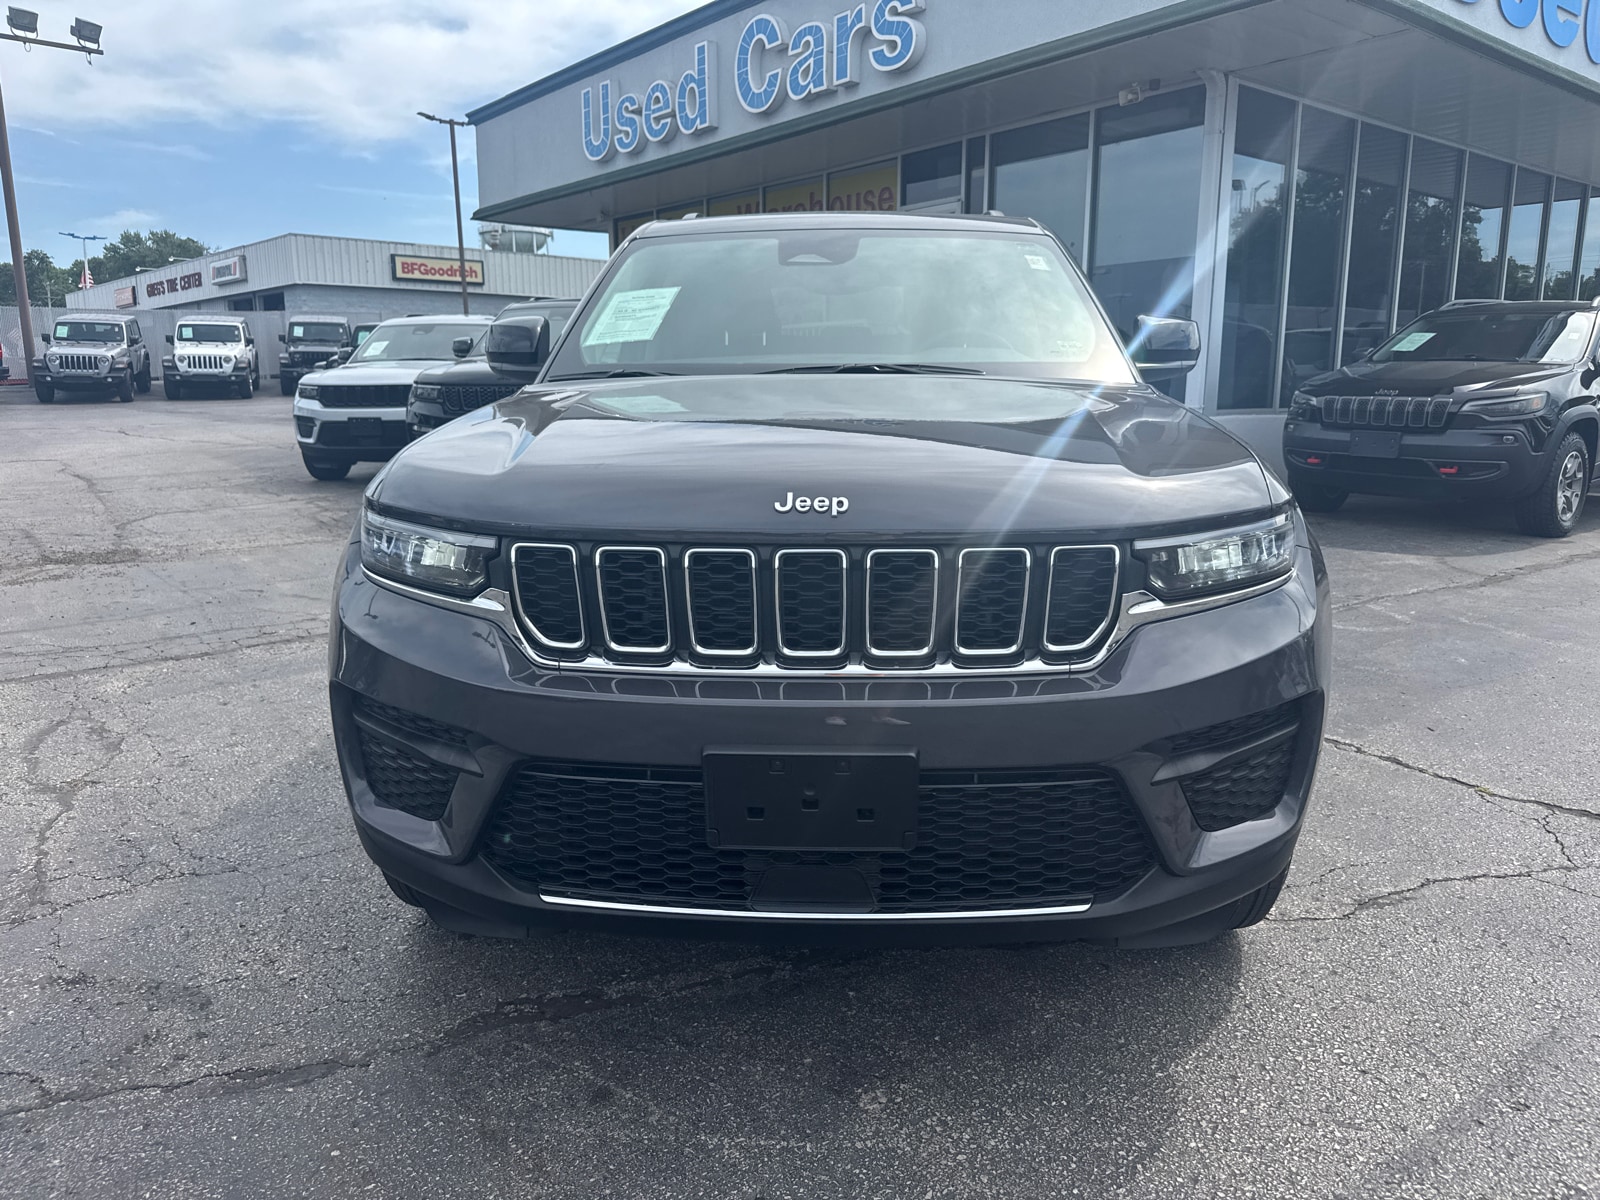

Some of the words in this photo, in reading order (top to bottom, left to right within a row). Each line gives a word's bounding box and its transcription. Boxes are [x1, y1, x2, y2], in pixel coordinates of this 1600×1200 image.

[580, 40, 710, 162] Used
[734, 0, 922, 114] Cars
[735, 185, 895, 214] house
[180, 272, 203, 291] CENTER
[774, 491, 849, 517] Jeep
